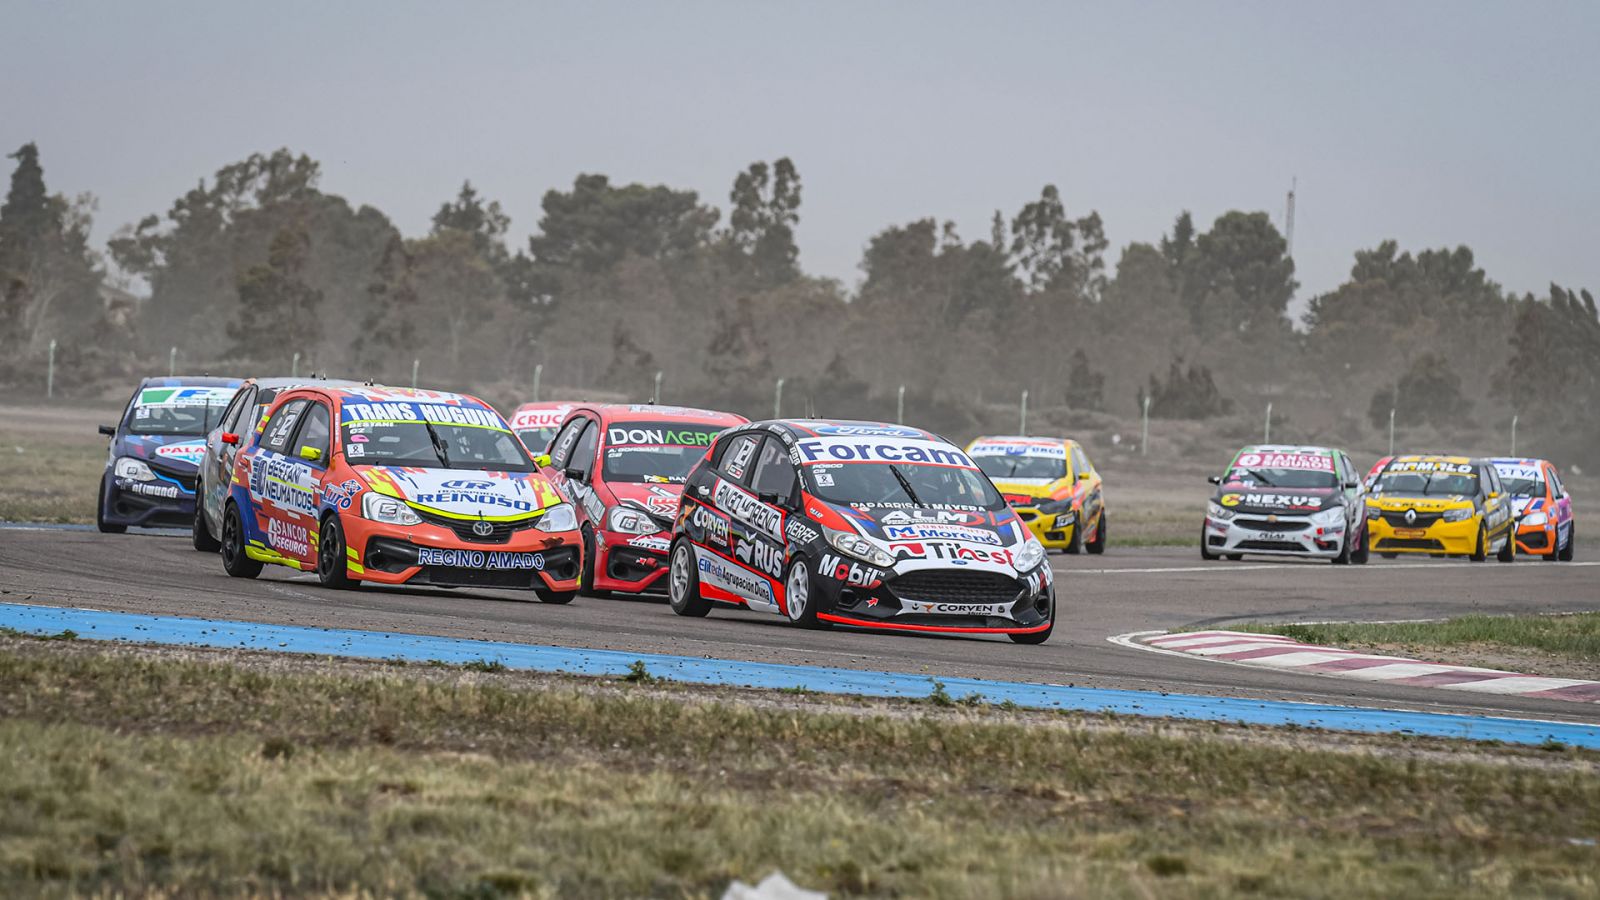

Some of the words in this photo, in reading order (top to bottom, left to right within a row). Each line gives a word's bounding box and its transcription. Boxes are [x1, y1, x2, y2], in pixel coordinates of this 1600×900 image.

[342, 403, 417, 421] TRANS
[835, 427, 905, 437] Ford
[797, 441, 972, 466] Forcam
[263, 480, 314, 511] NEUMATICOS
[416, 493, 532, 512] REINOSO
[1246, 494, 1322, 507] NEXUS
[693, 505, 728, 541] CORVEN
[881, 510, 968, 525] ALM
[276, 519, 307, 543] SANCOR
[919, 529, 998, 545] Moreno
[275, 537, 308, 557] SEGUROS
[418, 548, 484, 567] REGINO
[486, 551, 545, 570] AMADO
[754, 540, 783, 578] RUS
[818, 553, 879, 586] Mobil
[937, 604, 993, 612] CORVEN
